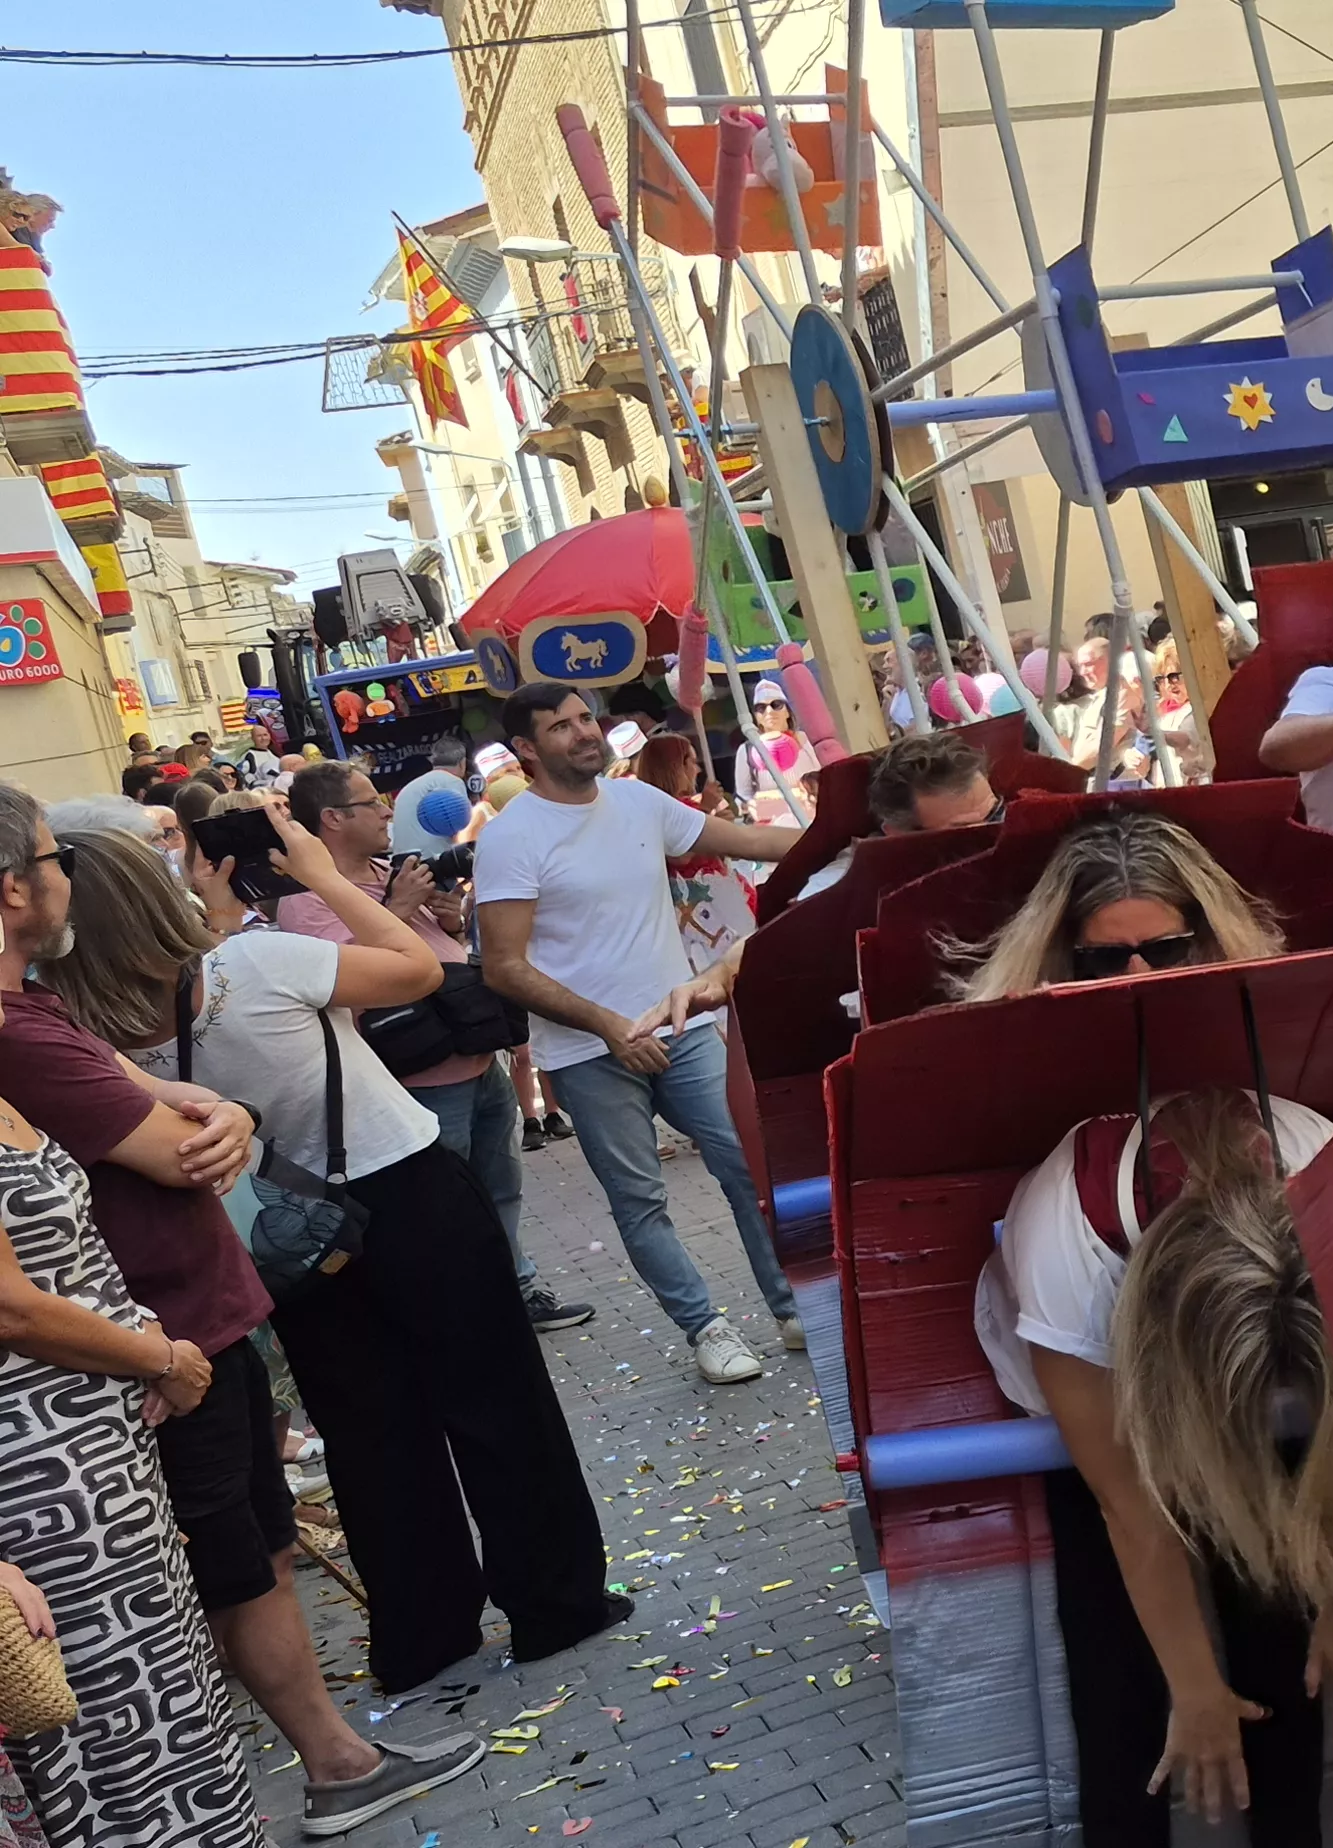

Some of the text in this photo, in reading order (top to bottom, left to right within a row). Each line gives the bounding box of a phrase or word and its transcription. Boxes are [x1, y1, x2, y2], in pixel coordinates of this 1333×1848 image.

[987, 518, 1013, 555] NCHE
[0, 663, 60, 681] URO 6000
[469, 777, 483, 792] 67
